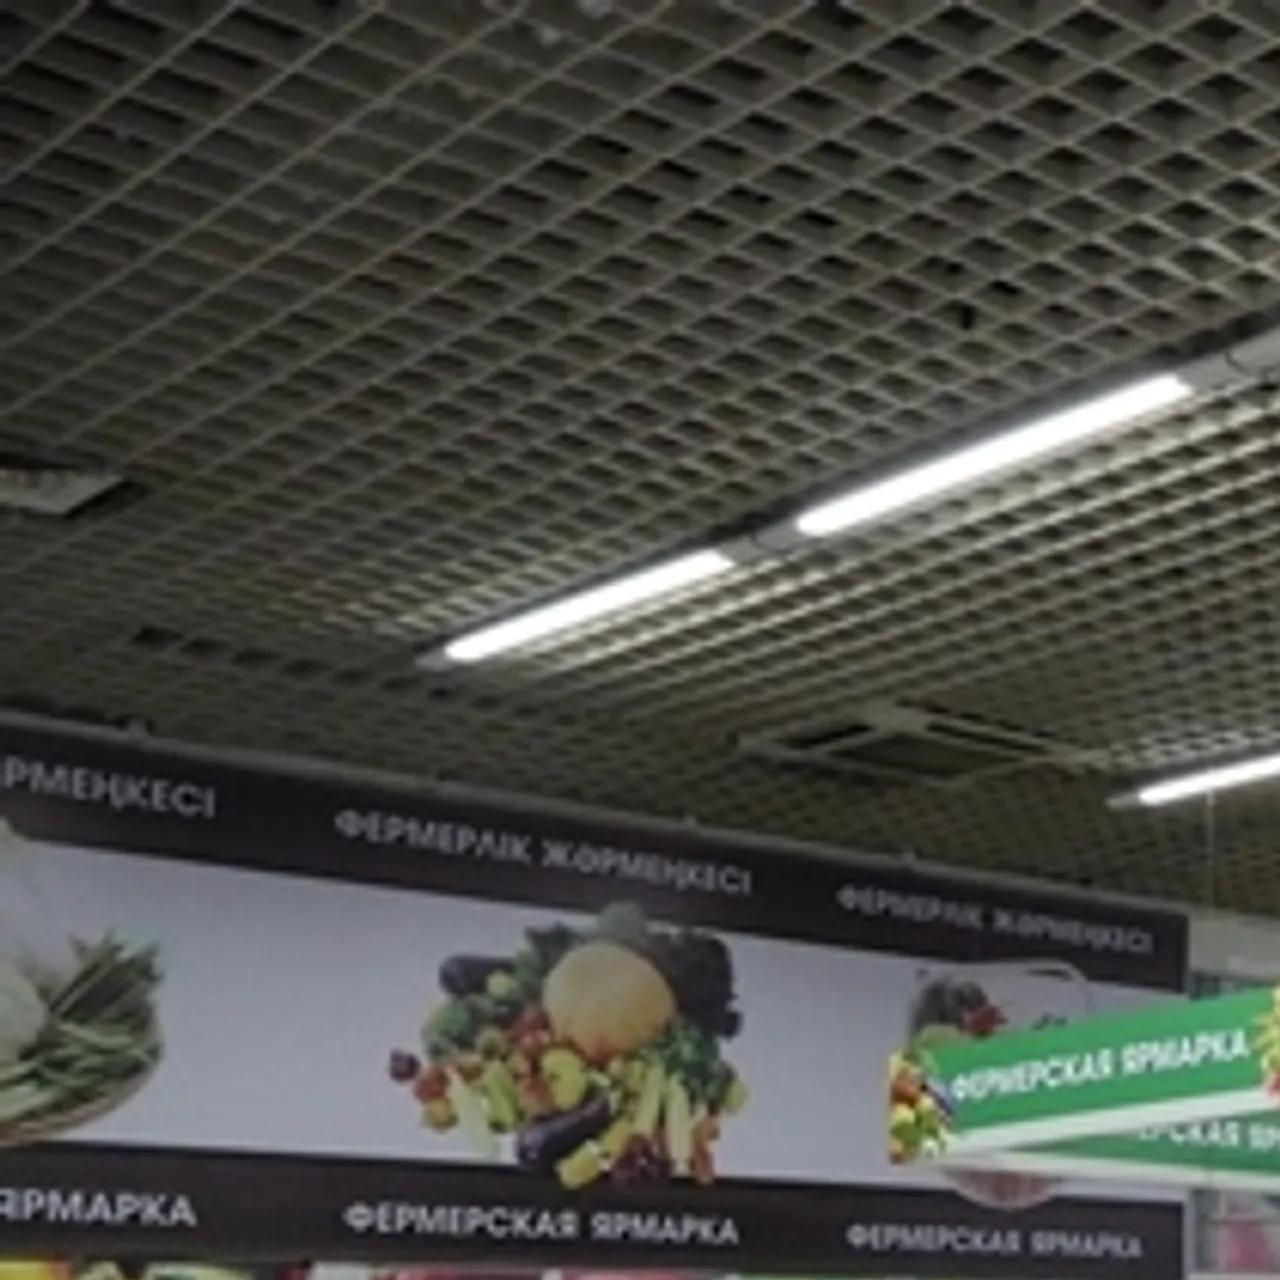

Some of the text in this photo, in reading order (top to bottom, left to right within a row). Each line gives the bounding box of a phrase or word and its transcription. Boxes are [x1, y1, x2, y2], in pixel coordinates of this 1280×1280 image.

[0, 755, 217, 820] РМЕҢКЕСІ
[952, 1028, 1250, 1101] ФЕРМЕРСКАЯ ЯРМАРКА
[0, 1187, 198, 1228] ЯРМАРКА
[341, 1200, 741, 1246] ФЕРМЕРСКАЯ ЯРМАРКА
[845, 1223, 1143, 1259] ФЕРМЕРСКАЯ ЯРМАРКА
